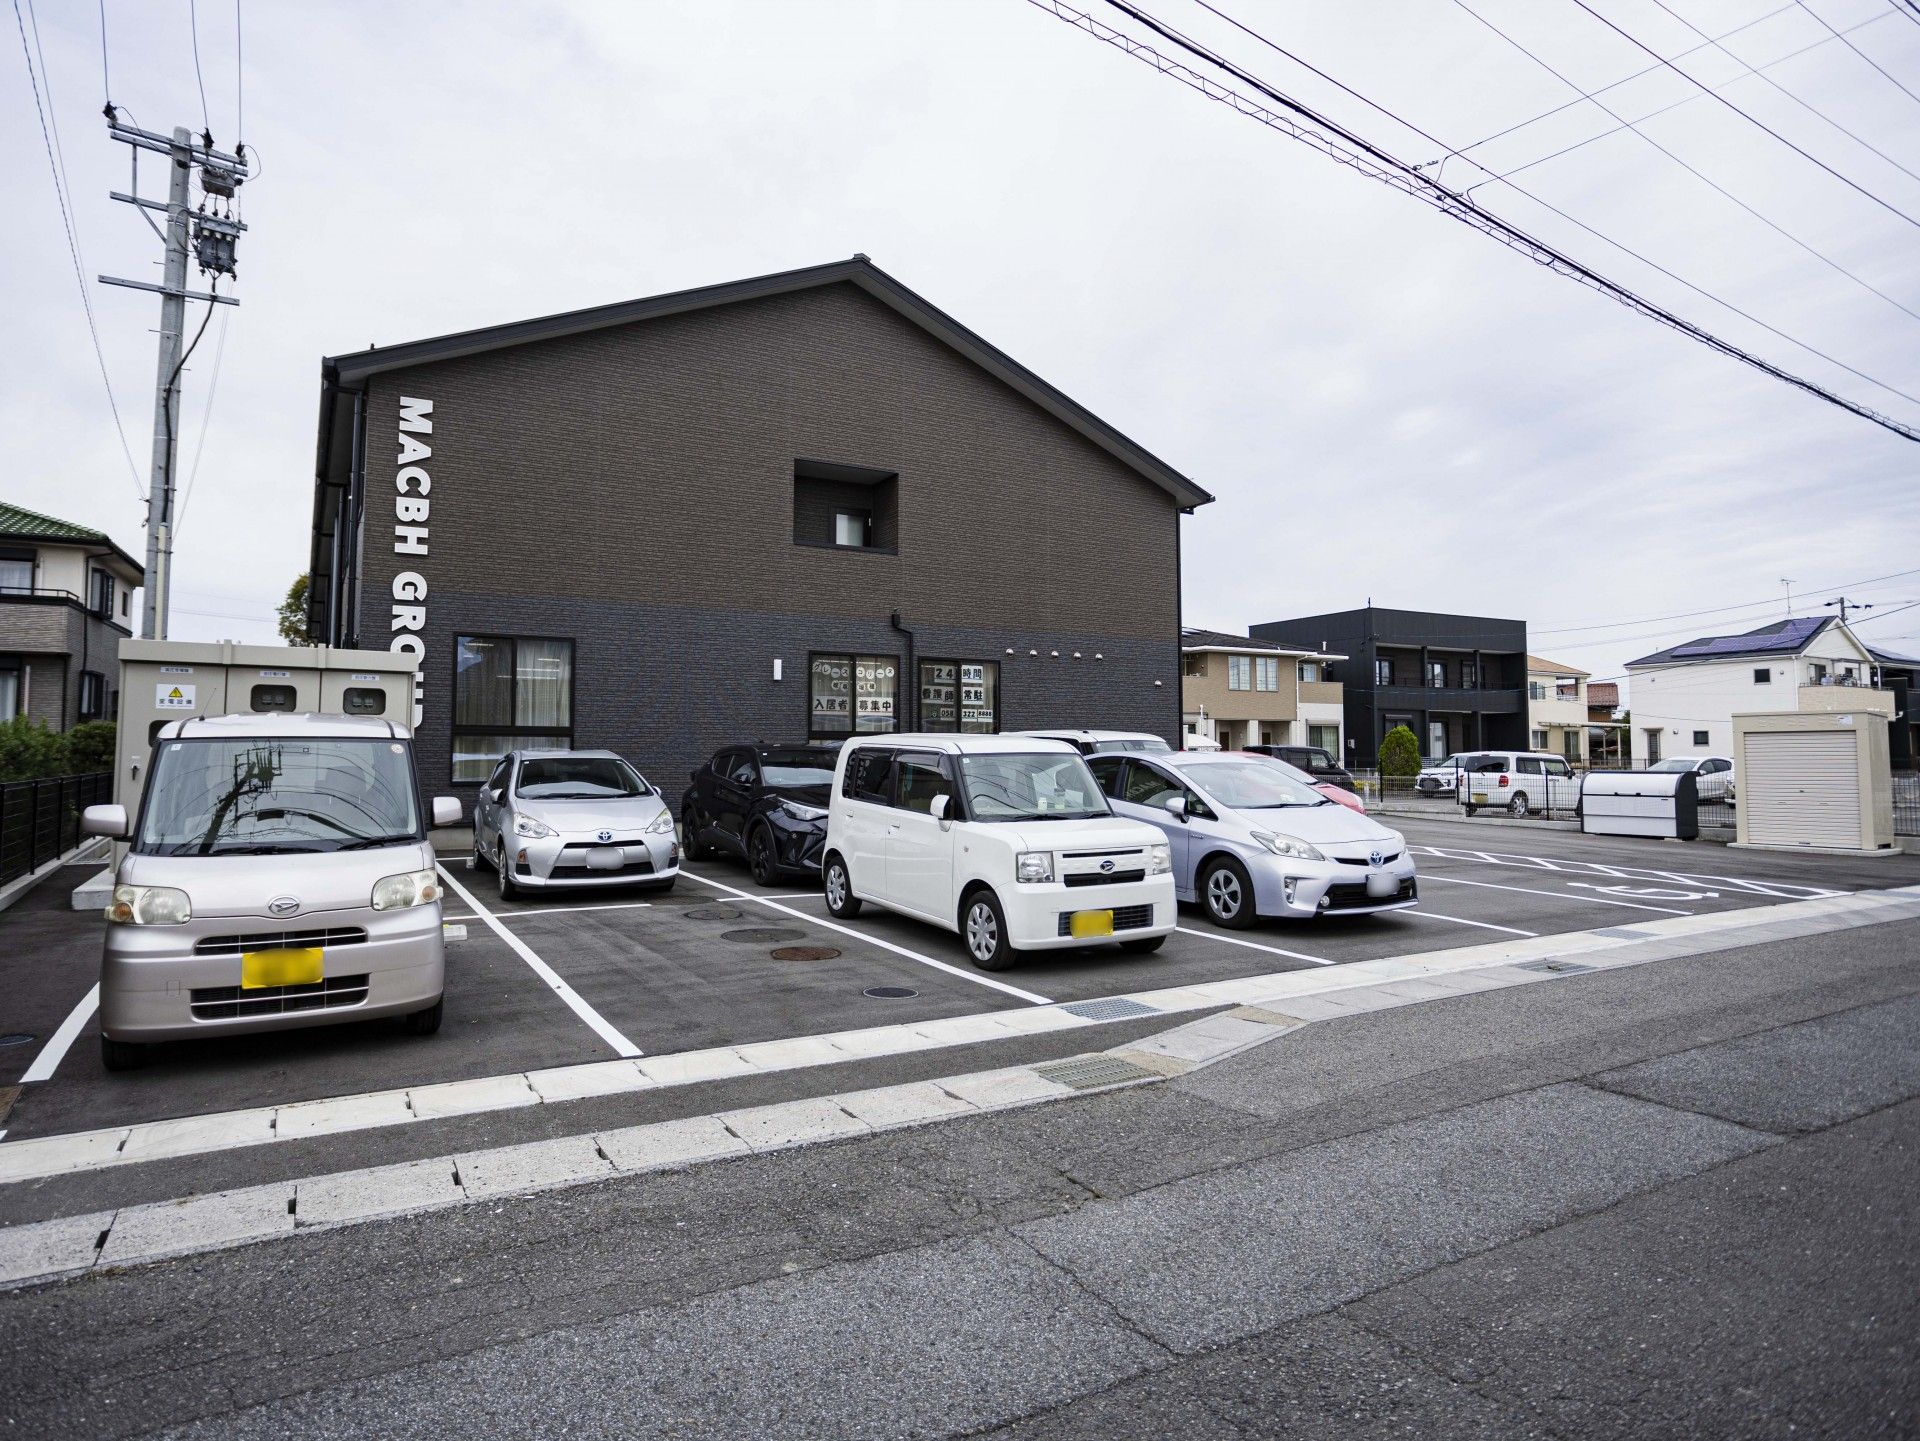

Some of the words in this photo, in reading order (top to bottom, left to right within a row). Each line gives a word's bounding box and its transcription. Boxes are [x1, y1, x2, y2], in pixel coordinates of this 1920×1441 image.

[394, 396, 434, 555] MACBH
[389, 571, 428, 729] GRO
[935, 667, 954, 678] 24
[962, 667, 982, 679] 時間
[814, 698, 848, 710] 入居者
[859, 699, 891, 711] 募集中
